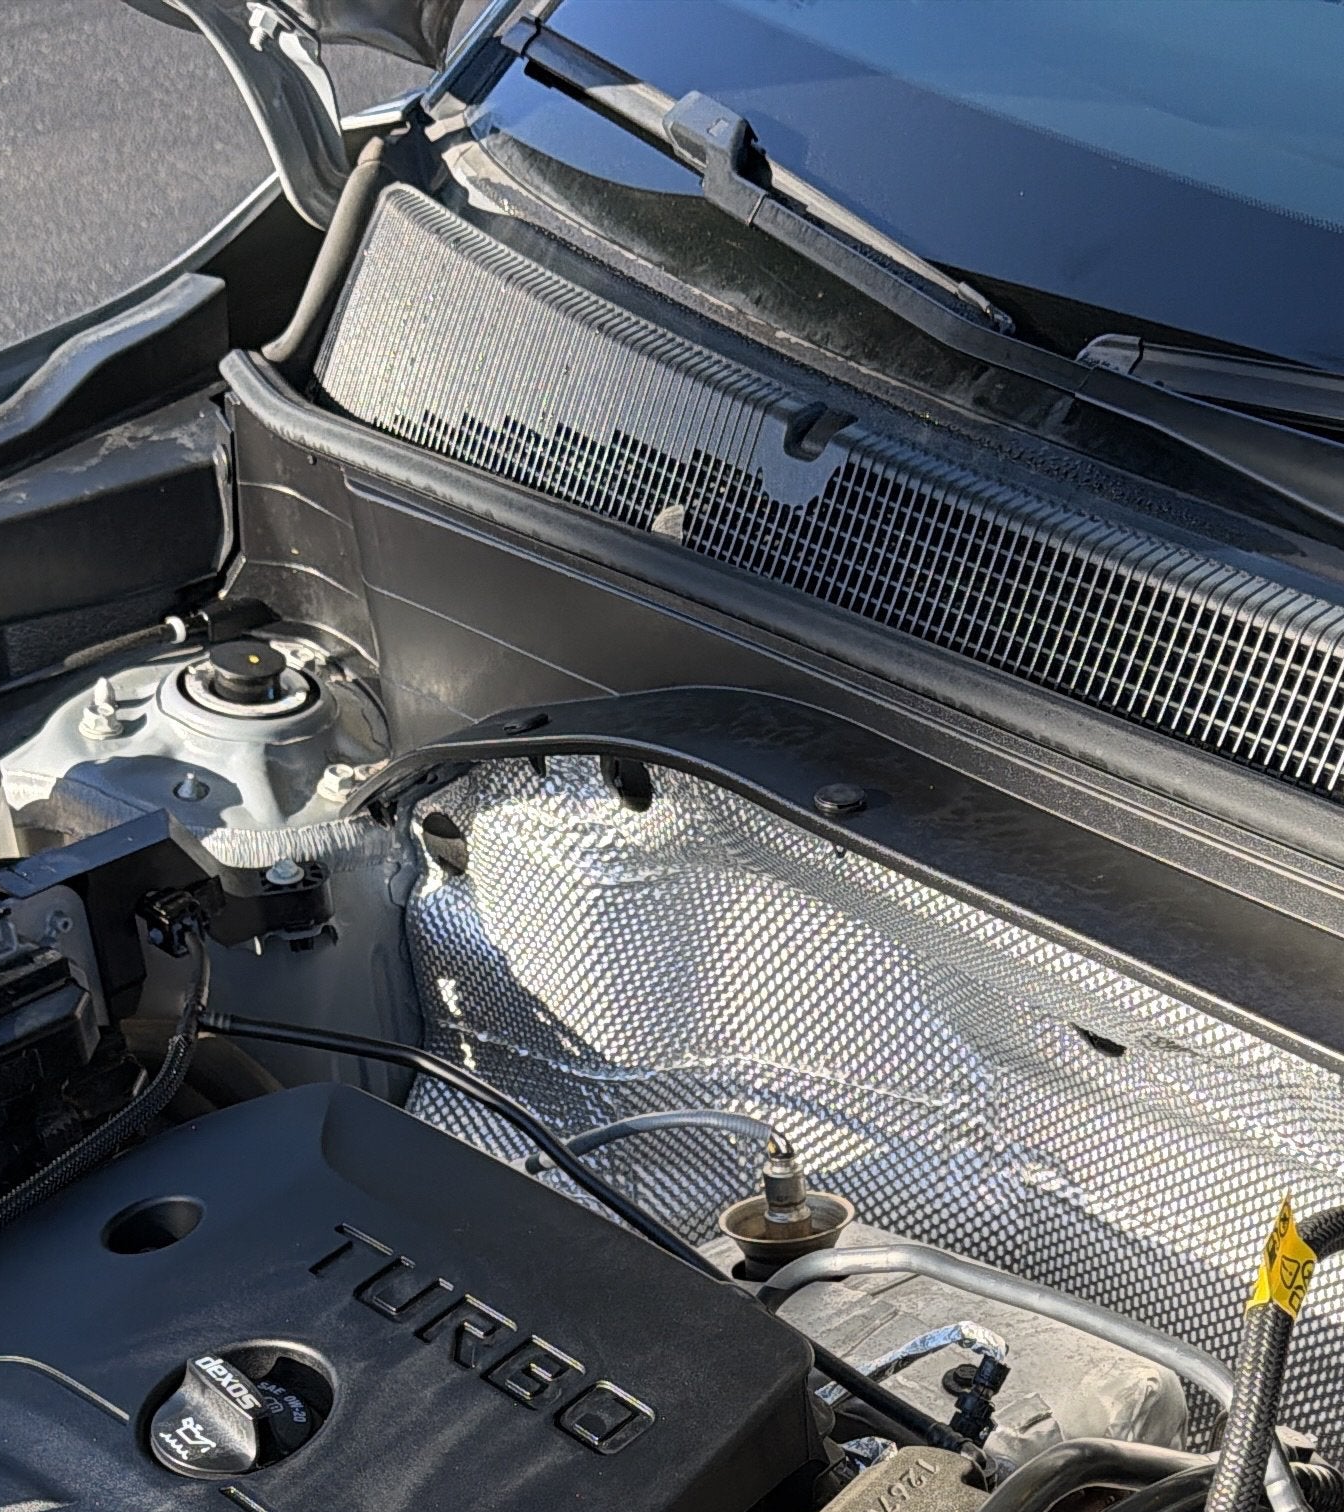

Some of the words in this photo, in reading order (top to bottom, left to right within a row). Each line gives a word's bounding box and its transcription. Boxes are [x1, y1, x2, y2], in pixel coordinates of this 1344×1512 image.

[309, 1223, 655, 1454] TURBO
[195, 1356, 261, 1410] dexos
[257, 1381, 286, 1395] SAE
[284, 1395, 307, 1423] 0W-20
